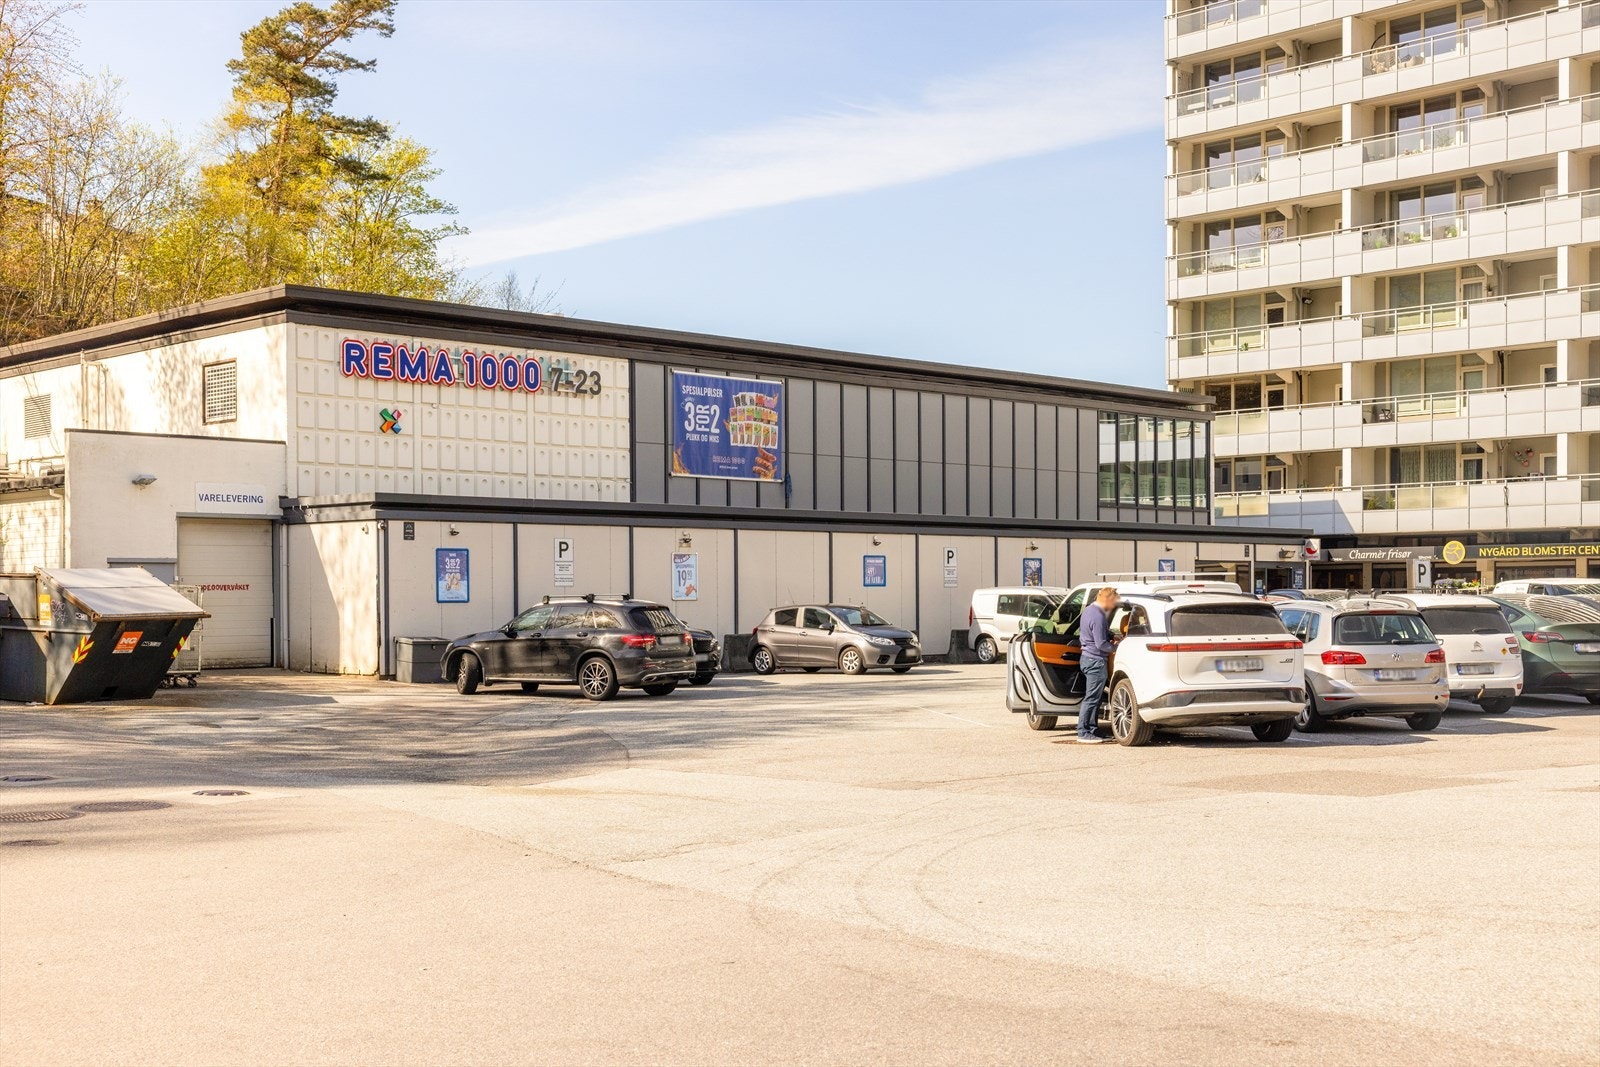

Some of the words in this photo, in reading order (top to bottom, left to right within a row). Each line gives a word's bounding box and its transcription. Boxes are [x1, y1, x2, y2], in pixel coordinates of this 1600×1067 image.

[341, 339, 455, 386] REMA
[463, 352, 541, 392] 1000
[550, 367, 601, 395] 7-23
[685, 402, 695, 432] 3
[695, 404, 710, 432] FOR
[710, 404, 720, 434] 2
[701, 434, 708, 442] OG
[198, 493, 264, 504] VARELEVERING
[558, 541, 569, 558] P
[947, 550, 954, 564] P
[1349, 549, 1387, 559] Charmèr
[1387, 548, 1412, 560] frisør
[1479, 545, 1520, 557] NYGÅRD
[1521, 545, 1577, 556] BLOMSTER
[677, 570, 687, 587] 19
[1418, 563, 1427, 583] P
[194, 583, 250, 591] DEOOVERVÅKET
